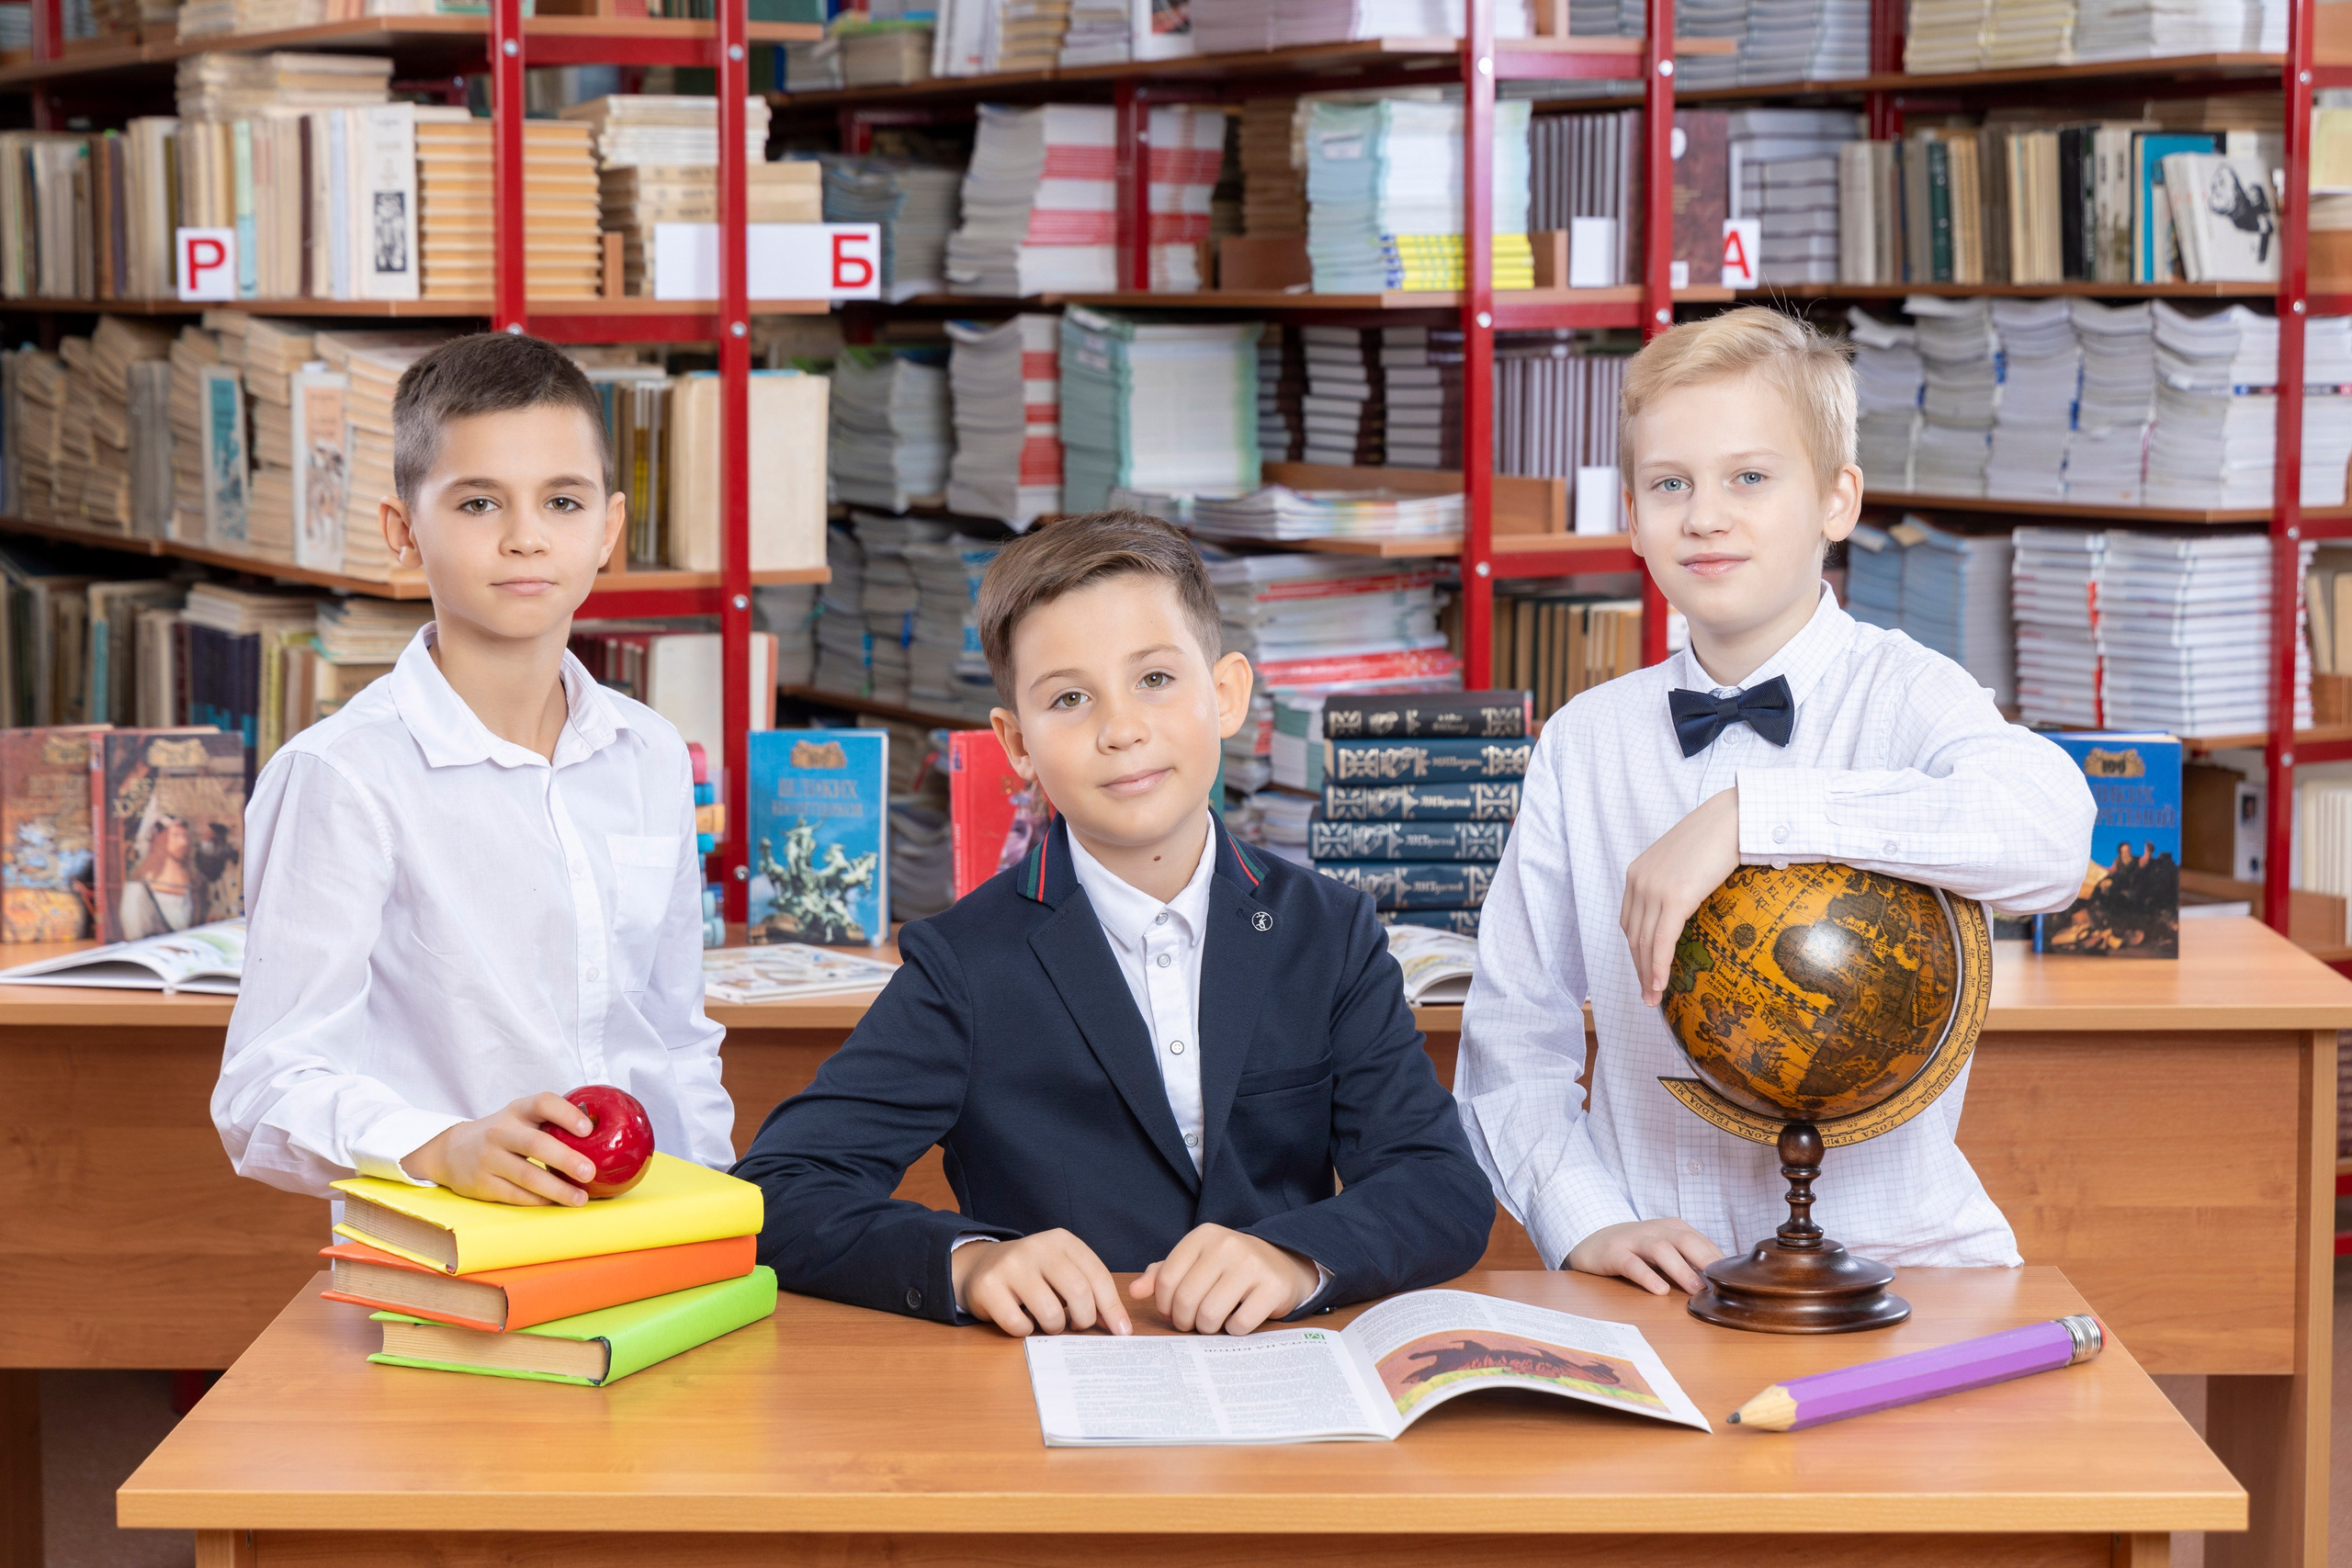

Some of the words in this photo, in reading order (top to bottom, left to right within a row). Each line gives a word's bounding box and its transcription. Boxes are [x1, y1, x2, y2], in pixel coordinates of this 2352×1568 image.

[187, 240, 225, 289] Р
[833, 234, 873, 288] Б
[1724, 231, 1749, 277] А
[1962, 1019, 1983, 1056] ZONA
[1920, 1063, 1961, 1105] TORRIDA
[1690, 1096, 1729, 1126] FREDDA
[1861, 1119, 1897, 1137] ZONA
[1737, 1125, 1772, 1142] ZONA
